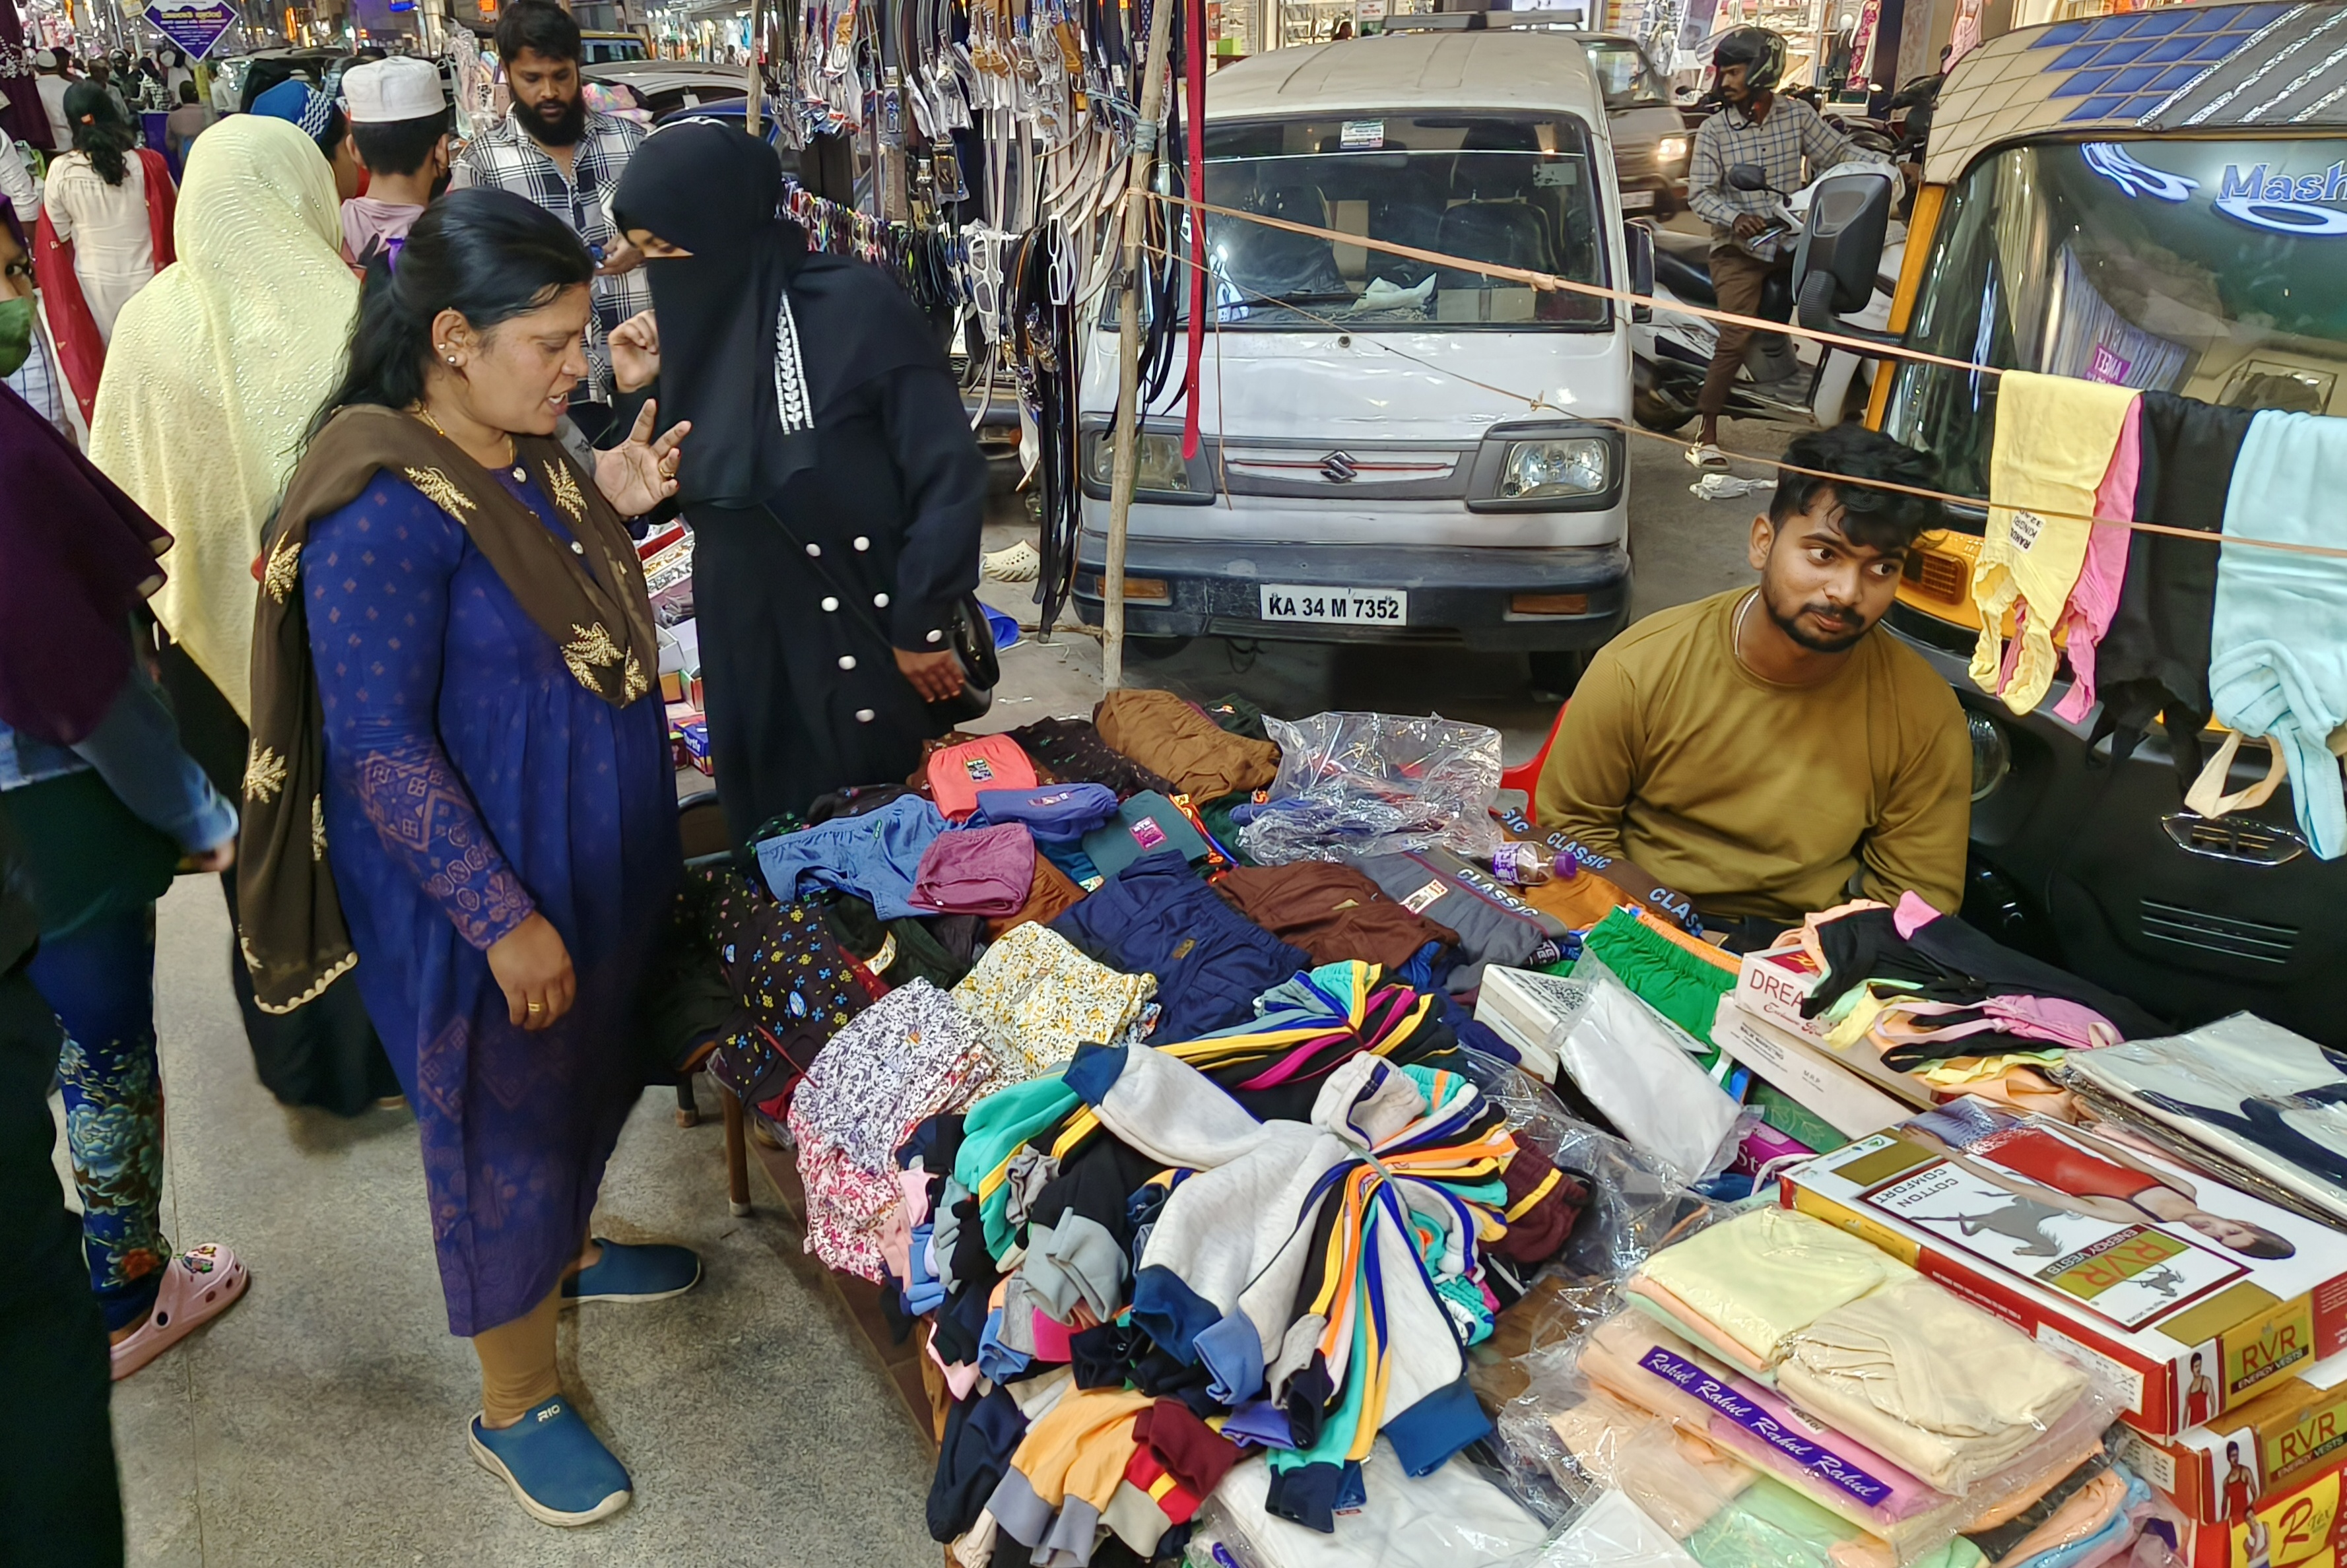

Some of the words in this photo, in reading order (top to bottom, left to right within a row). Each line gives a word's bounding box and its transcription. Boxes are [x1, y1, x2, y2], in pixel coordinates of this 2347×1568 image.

[1269, 597, 1296, 616] KA
[1302, 597, 1325, 616] 34
[1331, 599, 1346, 617] M
[1353, 599, 1399, 619] 7352
[1546, 832, 1612, 870] CLASSIC
[1456, 868, 1538, 917] CLASSIC
[1876, 1168, 1947, 1203] COMFORT
[1897, 1178, 1959, 1208] COTTON
[2090, 1228, 2139, 1255] ENERGY
[2046, 1252, 2091, 1276] VESTS
[2067, 1239, 2173, 1287] RVR
[2238, 1363, 2274, 1389] ENERGY
[2274, 1348, 2303, 1369] VESTS
[2241, 1324, 2297, 1375] RVR
[537, 1404, 560, 1422] RIO
[1647, 1353, 1697, 1384] Rahul
[1695, 1380, 1752, 1418] Rahul
[1750, 1416, 1813, 1455] Rahul
[1812, 1455, 1880, 1497] Rahul
[2280, 1411, 2337, 1464] RVR
